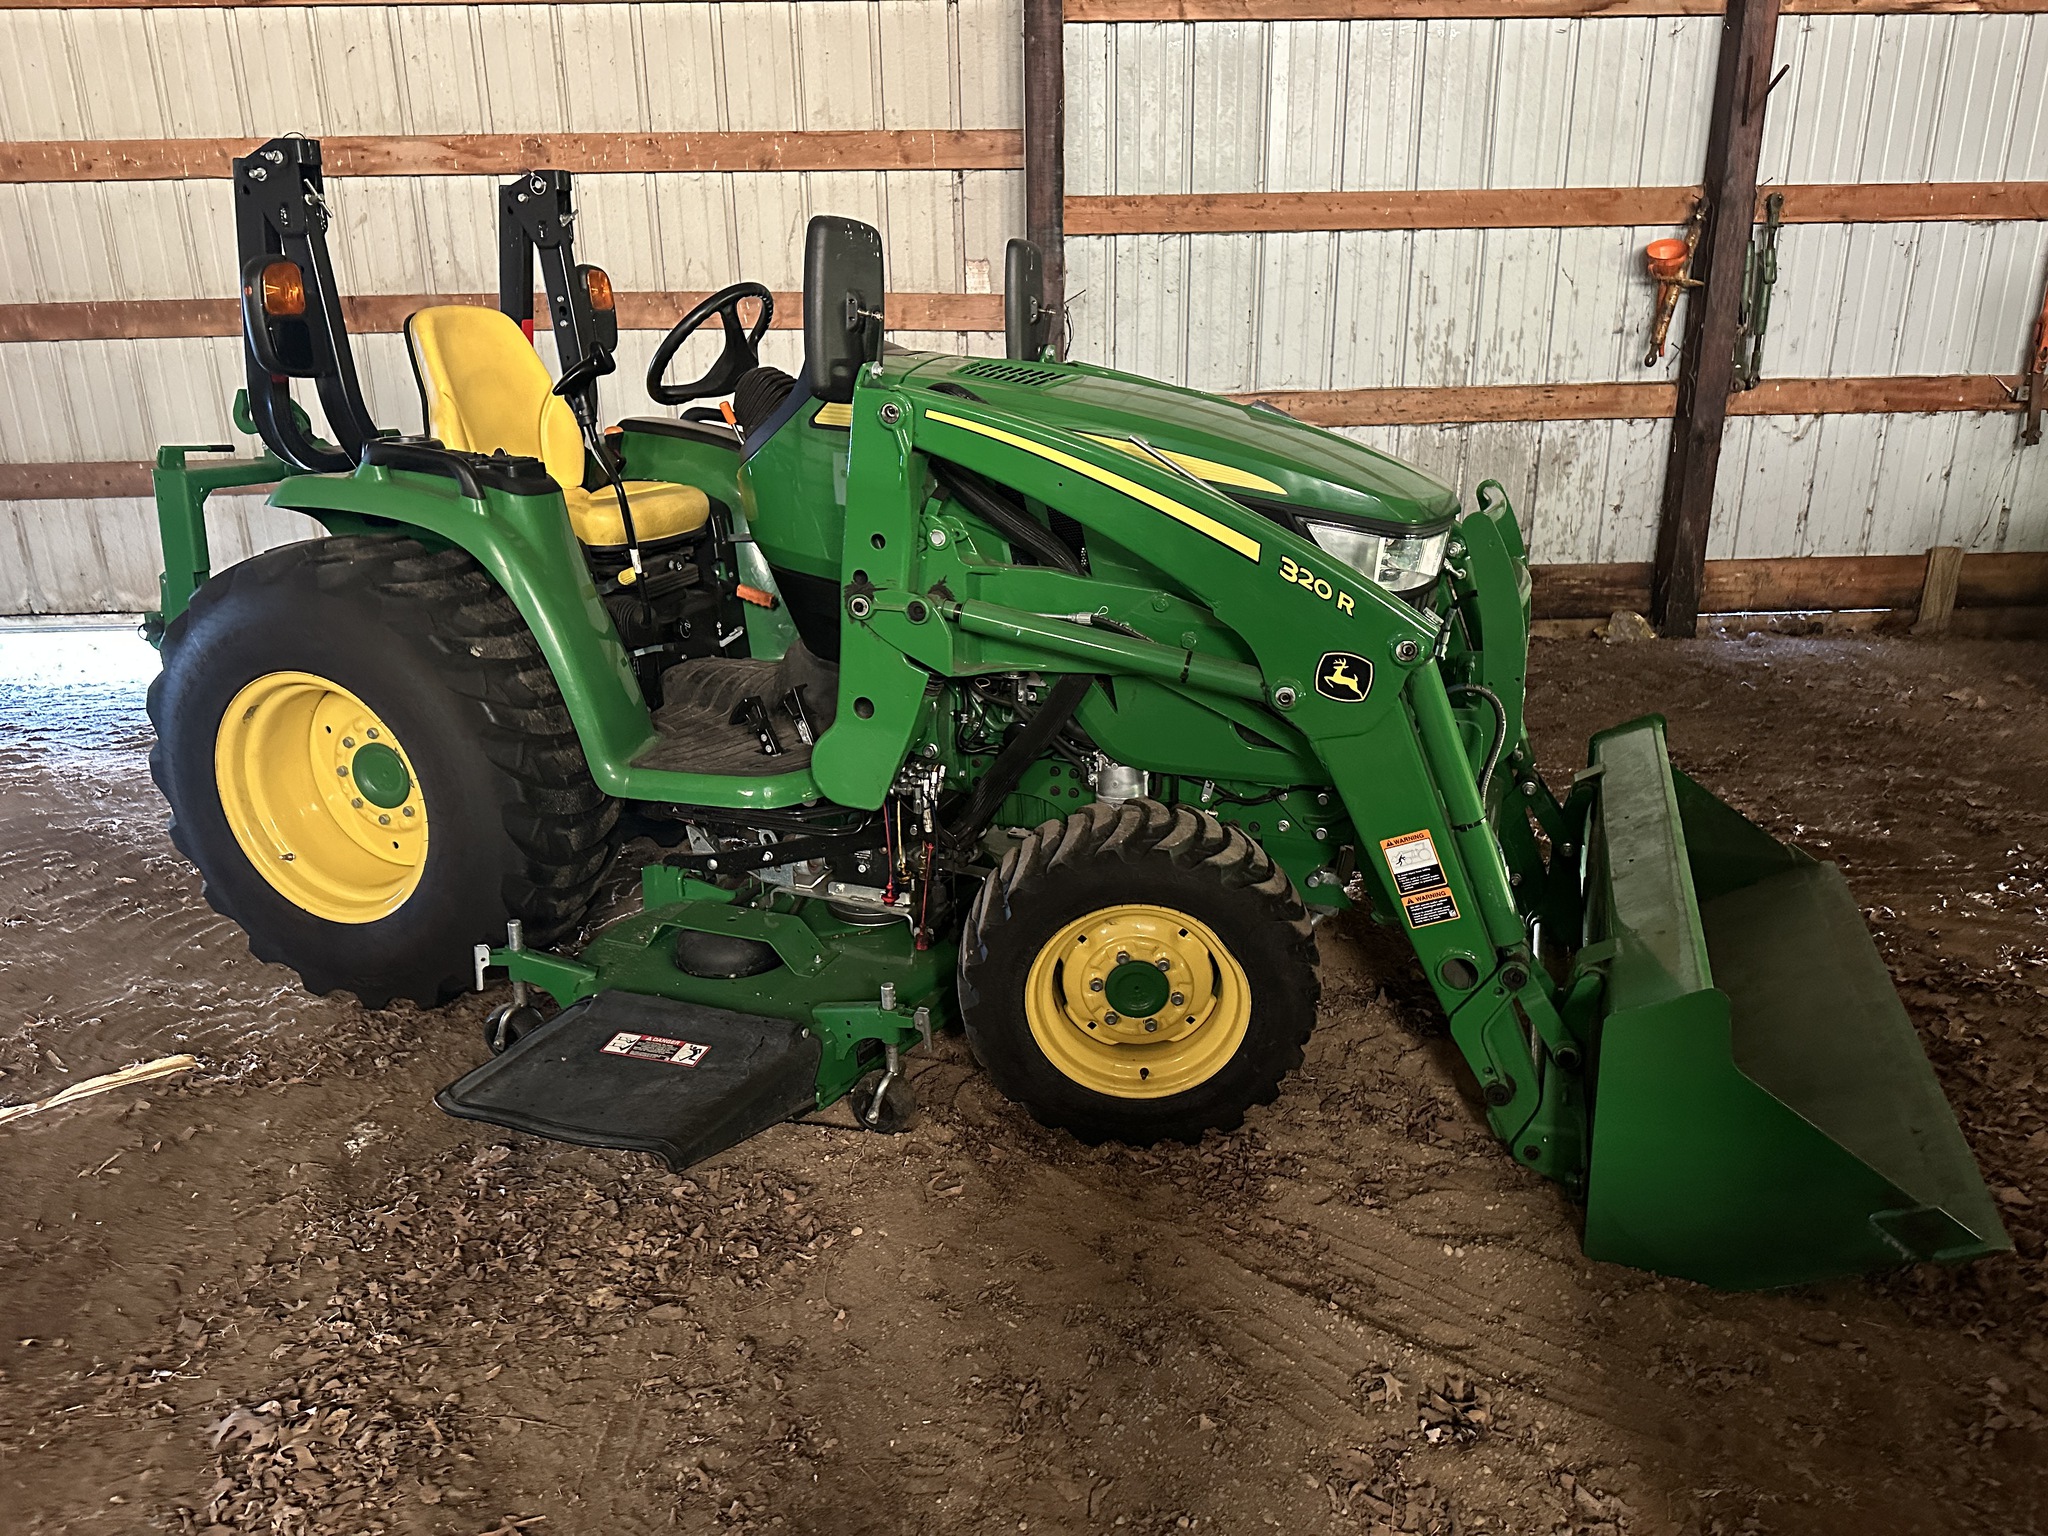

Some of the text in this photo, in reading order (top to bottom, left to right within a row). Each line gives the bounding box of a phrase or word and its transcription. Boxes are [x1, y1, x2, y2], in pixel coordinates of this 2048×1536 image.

[1279, 555, 1355, 618] 320 R
[1394, 833, 1425, 845] WARNING
[1415, 891, 1446, 902] WARNING
[652, 1036, 681, 1046] DANGER
